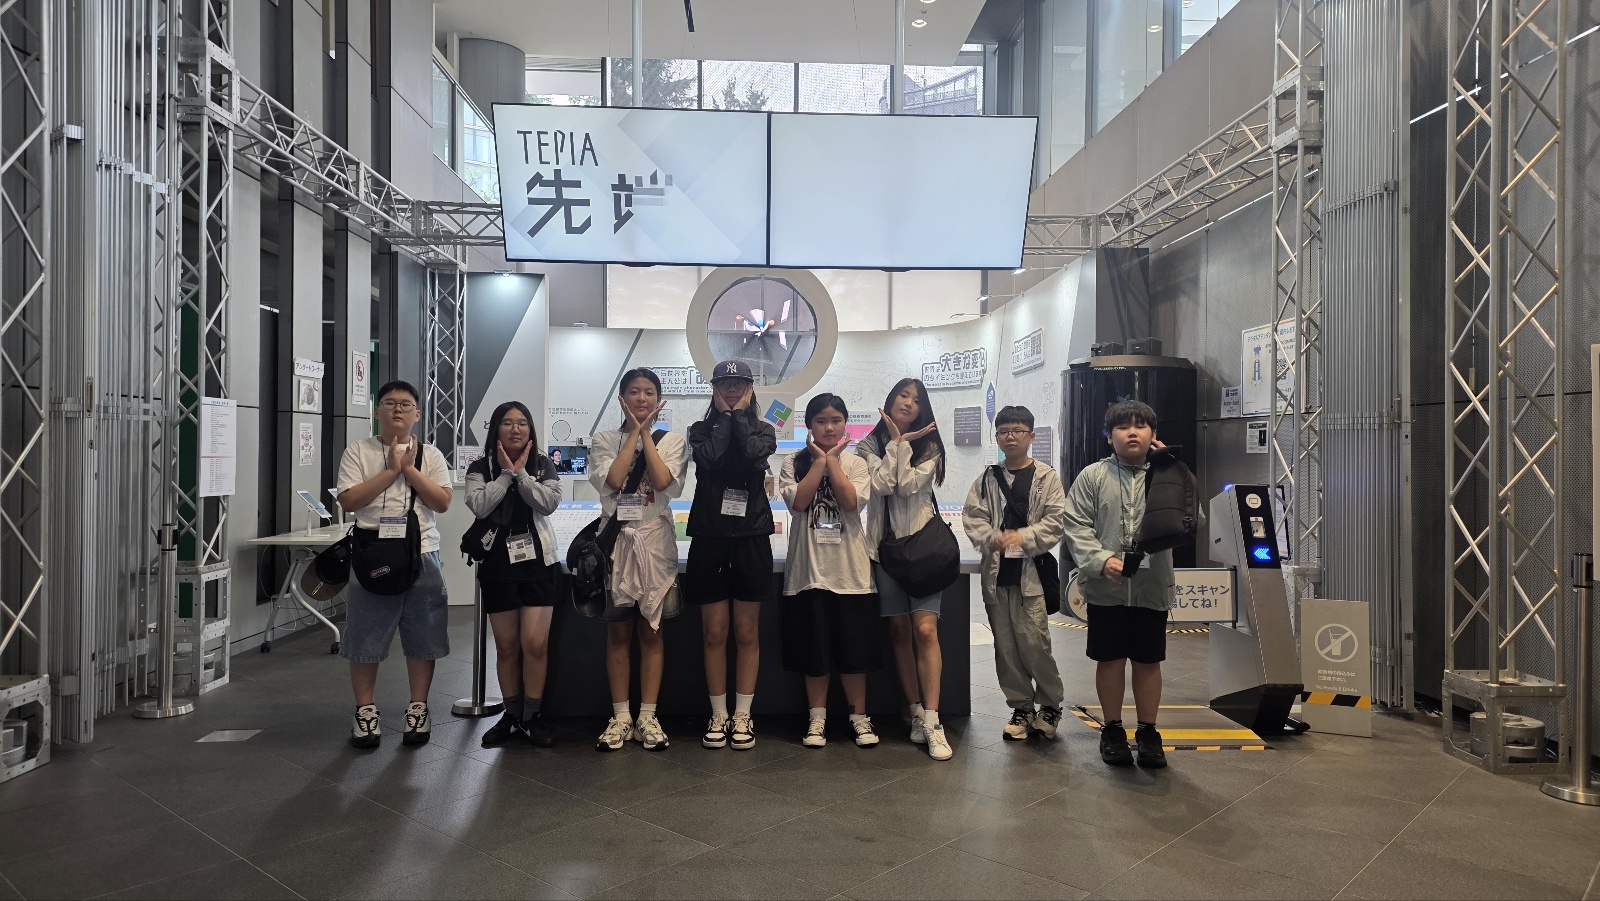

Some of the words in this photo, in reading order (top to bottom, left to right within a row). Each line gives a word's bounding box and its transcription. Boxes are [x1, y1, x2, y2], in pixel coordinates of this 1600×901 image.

[517, 130, 599, 166] TEPIA
[726, 362, 737, 374] NY
[1175, 584, 1230, 596] をスキャン
